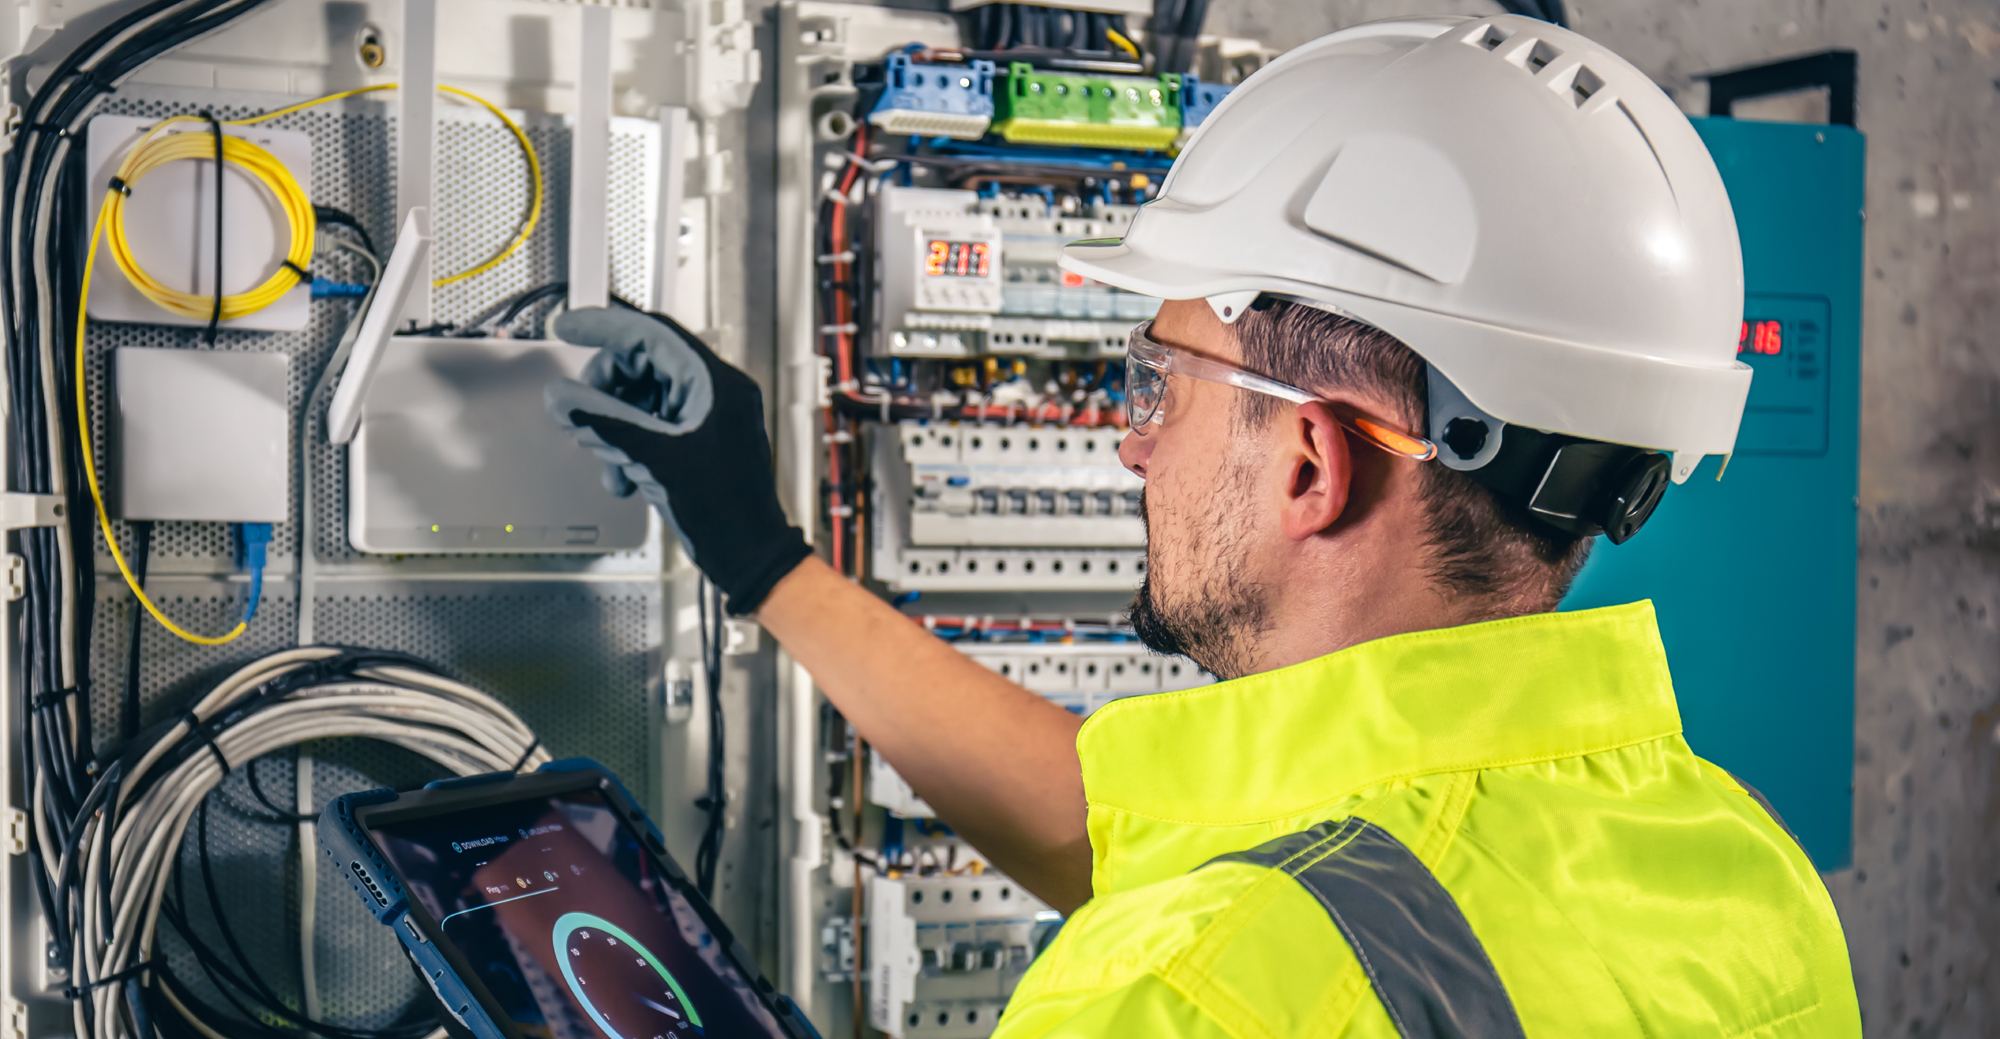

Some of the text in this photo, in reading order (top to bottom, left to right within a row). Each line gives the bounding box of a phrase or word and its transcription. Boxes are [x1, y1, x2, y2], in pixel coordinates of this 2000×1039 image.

[925, 241, 991, 277] 217
[461, 837, 495, 850] DOWNLOAD
[486, 886, 501, 894] Ping
